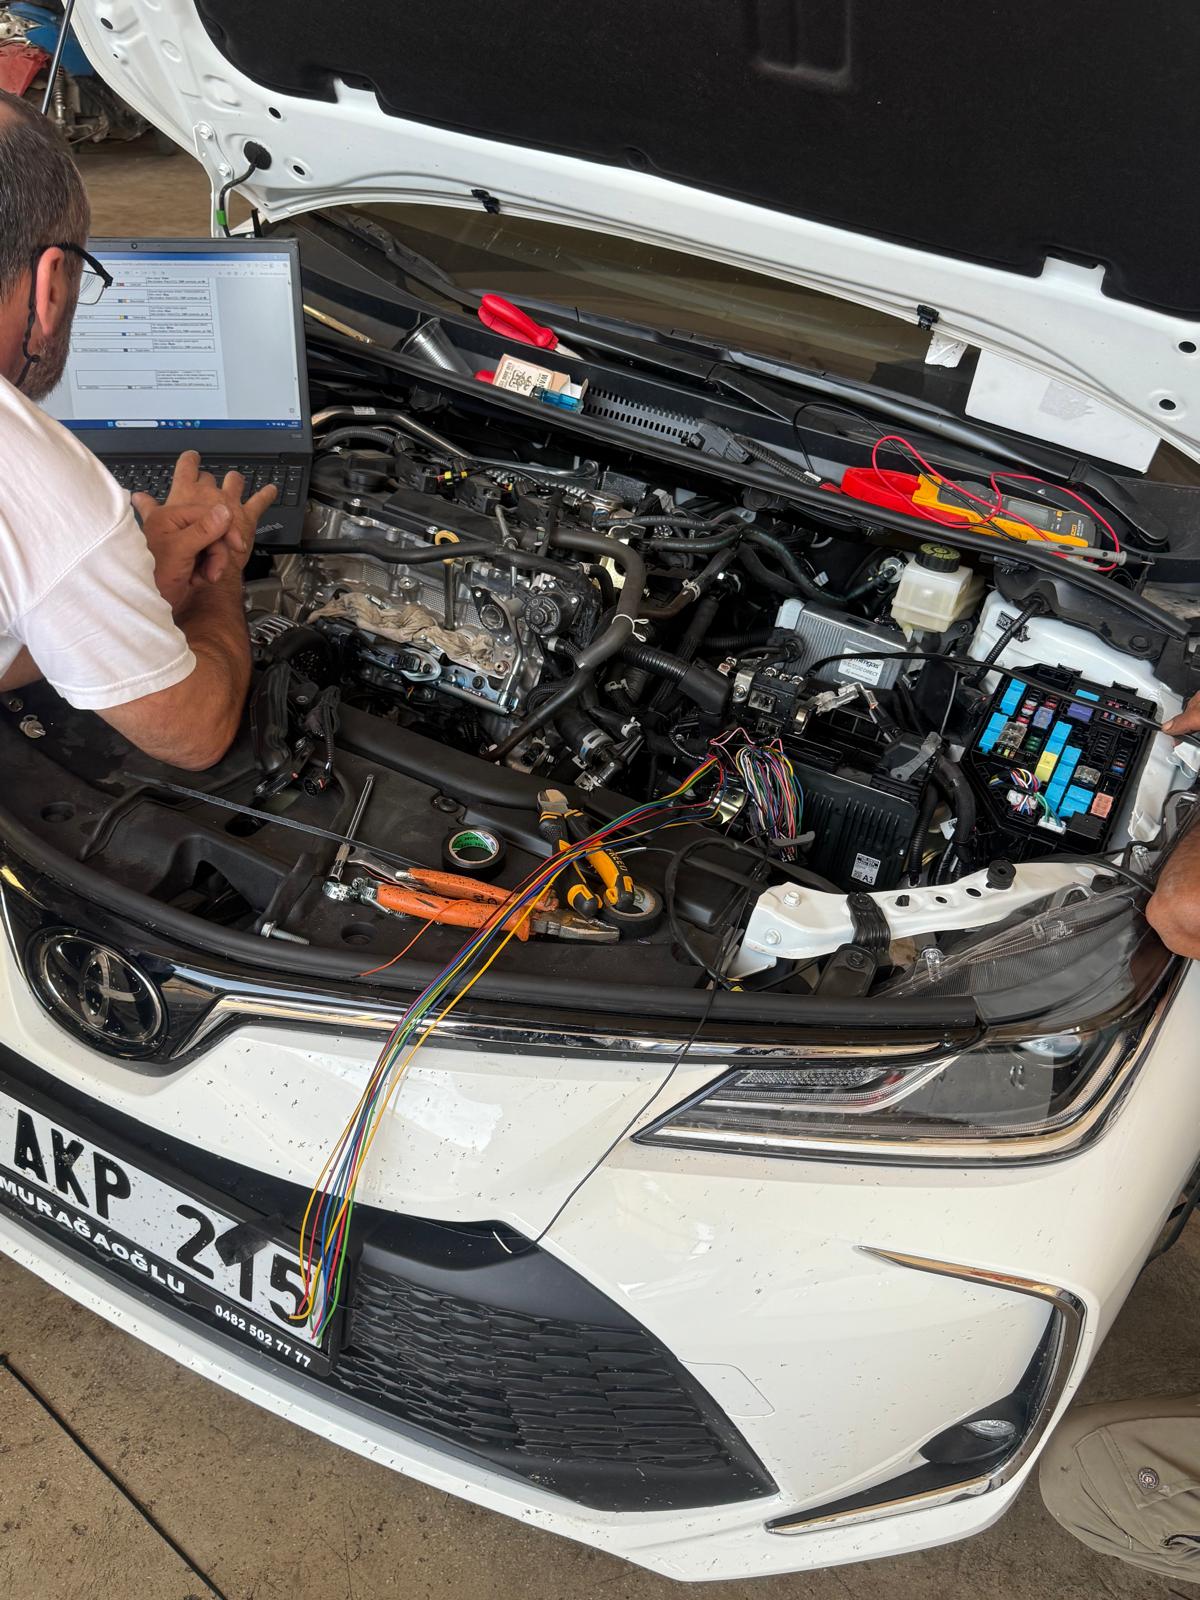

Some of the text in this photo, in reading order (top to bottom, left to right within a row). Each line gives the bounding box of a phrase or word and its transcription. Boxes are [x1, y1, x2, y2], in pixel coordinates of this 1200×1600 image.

[862, 875, 873, 883] A3
[14, 1109, 131, 1220] AKP
[0, 1175, 185, 1294] MURAĞAOĞLU
[215, 1304, 311, 1368] 0482 502 77 77
